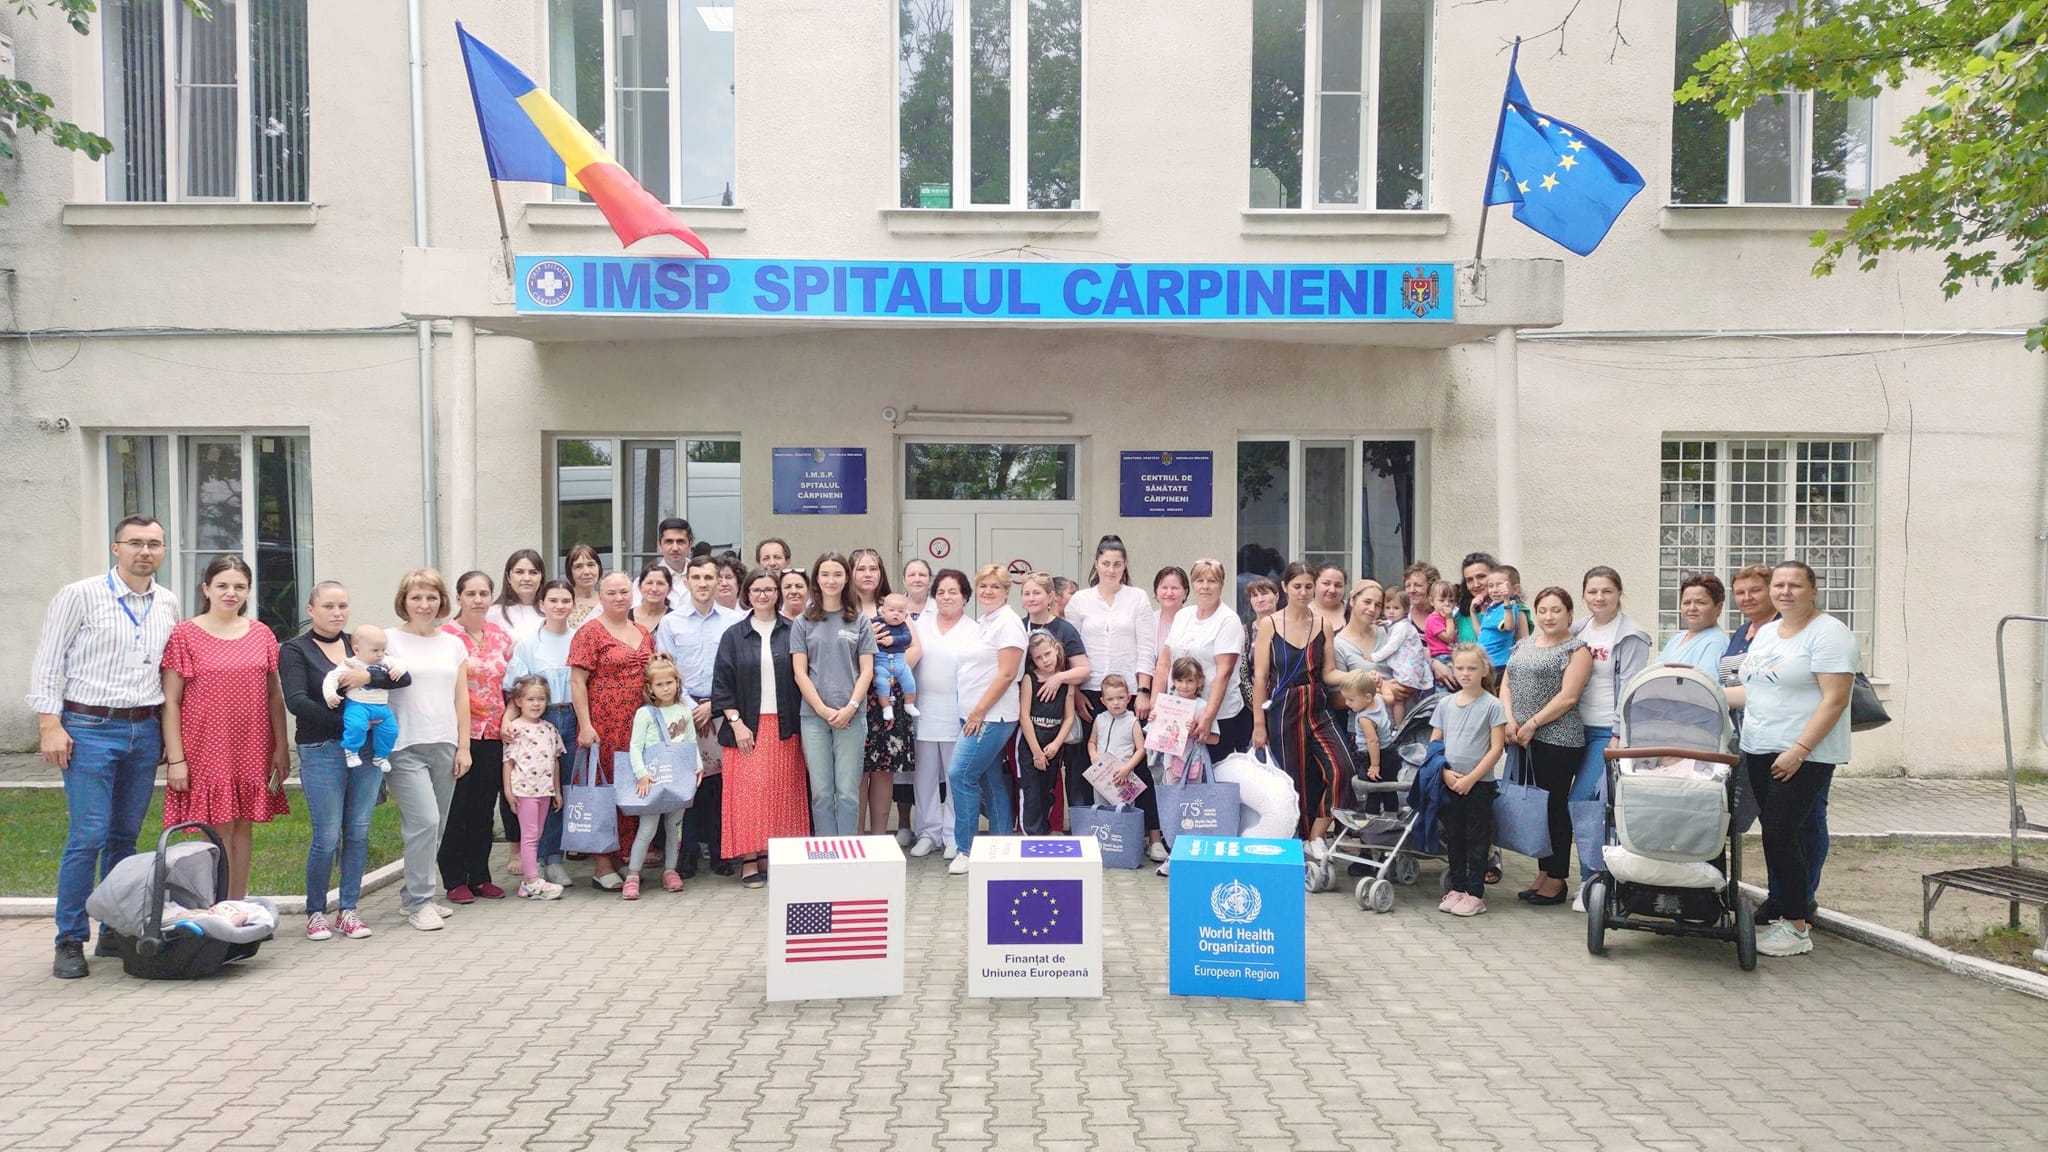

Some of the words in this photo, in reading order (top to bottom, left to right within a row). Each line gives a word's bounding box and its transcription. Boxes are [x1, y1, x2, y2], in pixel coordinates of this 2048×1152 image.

[583, 262, 730, 310] IMSP
[753, 265, 1041, 315] SPITALUL
[1063, 263, 1388, 315] CĂRPINENI
[1145, 484, 1188, 492] SĂNĂTATE
[1179, 801, 1201, 817] 75
[1090, 825, 1109, 840] 75
[1199, 926, 1233, 939] World
[1237, 928, 1275, 941] Health
[1199, 940, 1275, 955] Organization
[1052, 954, 1066, 963] de
[982, 968, 1027, 978] Uniunea
[1030, 968, 1089, 979] Europeană
[1194, 965, 1242, 979] European
[1244, 967, 1280, 982] Region
